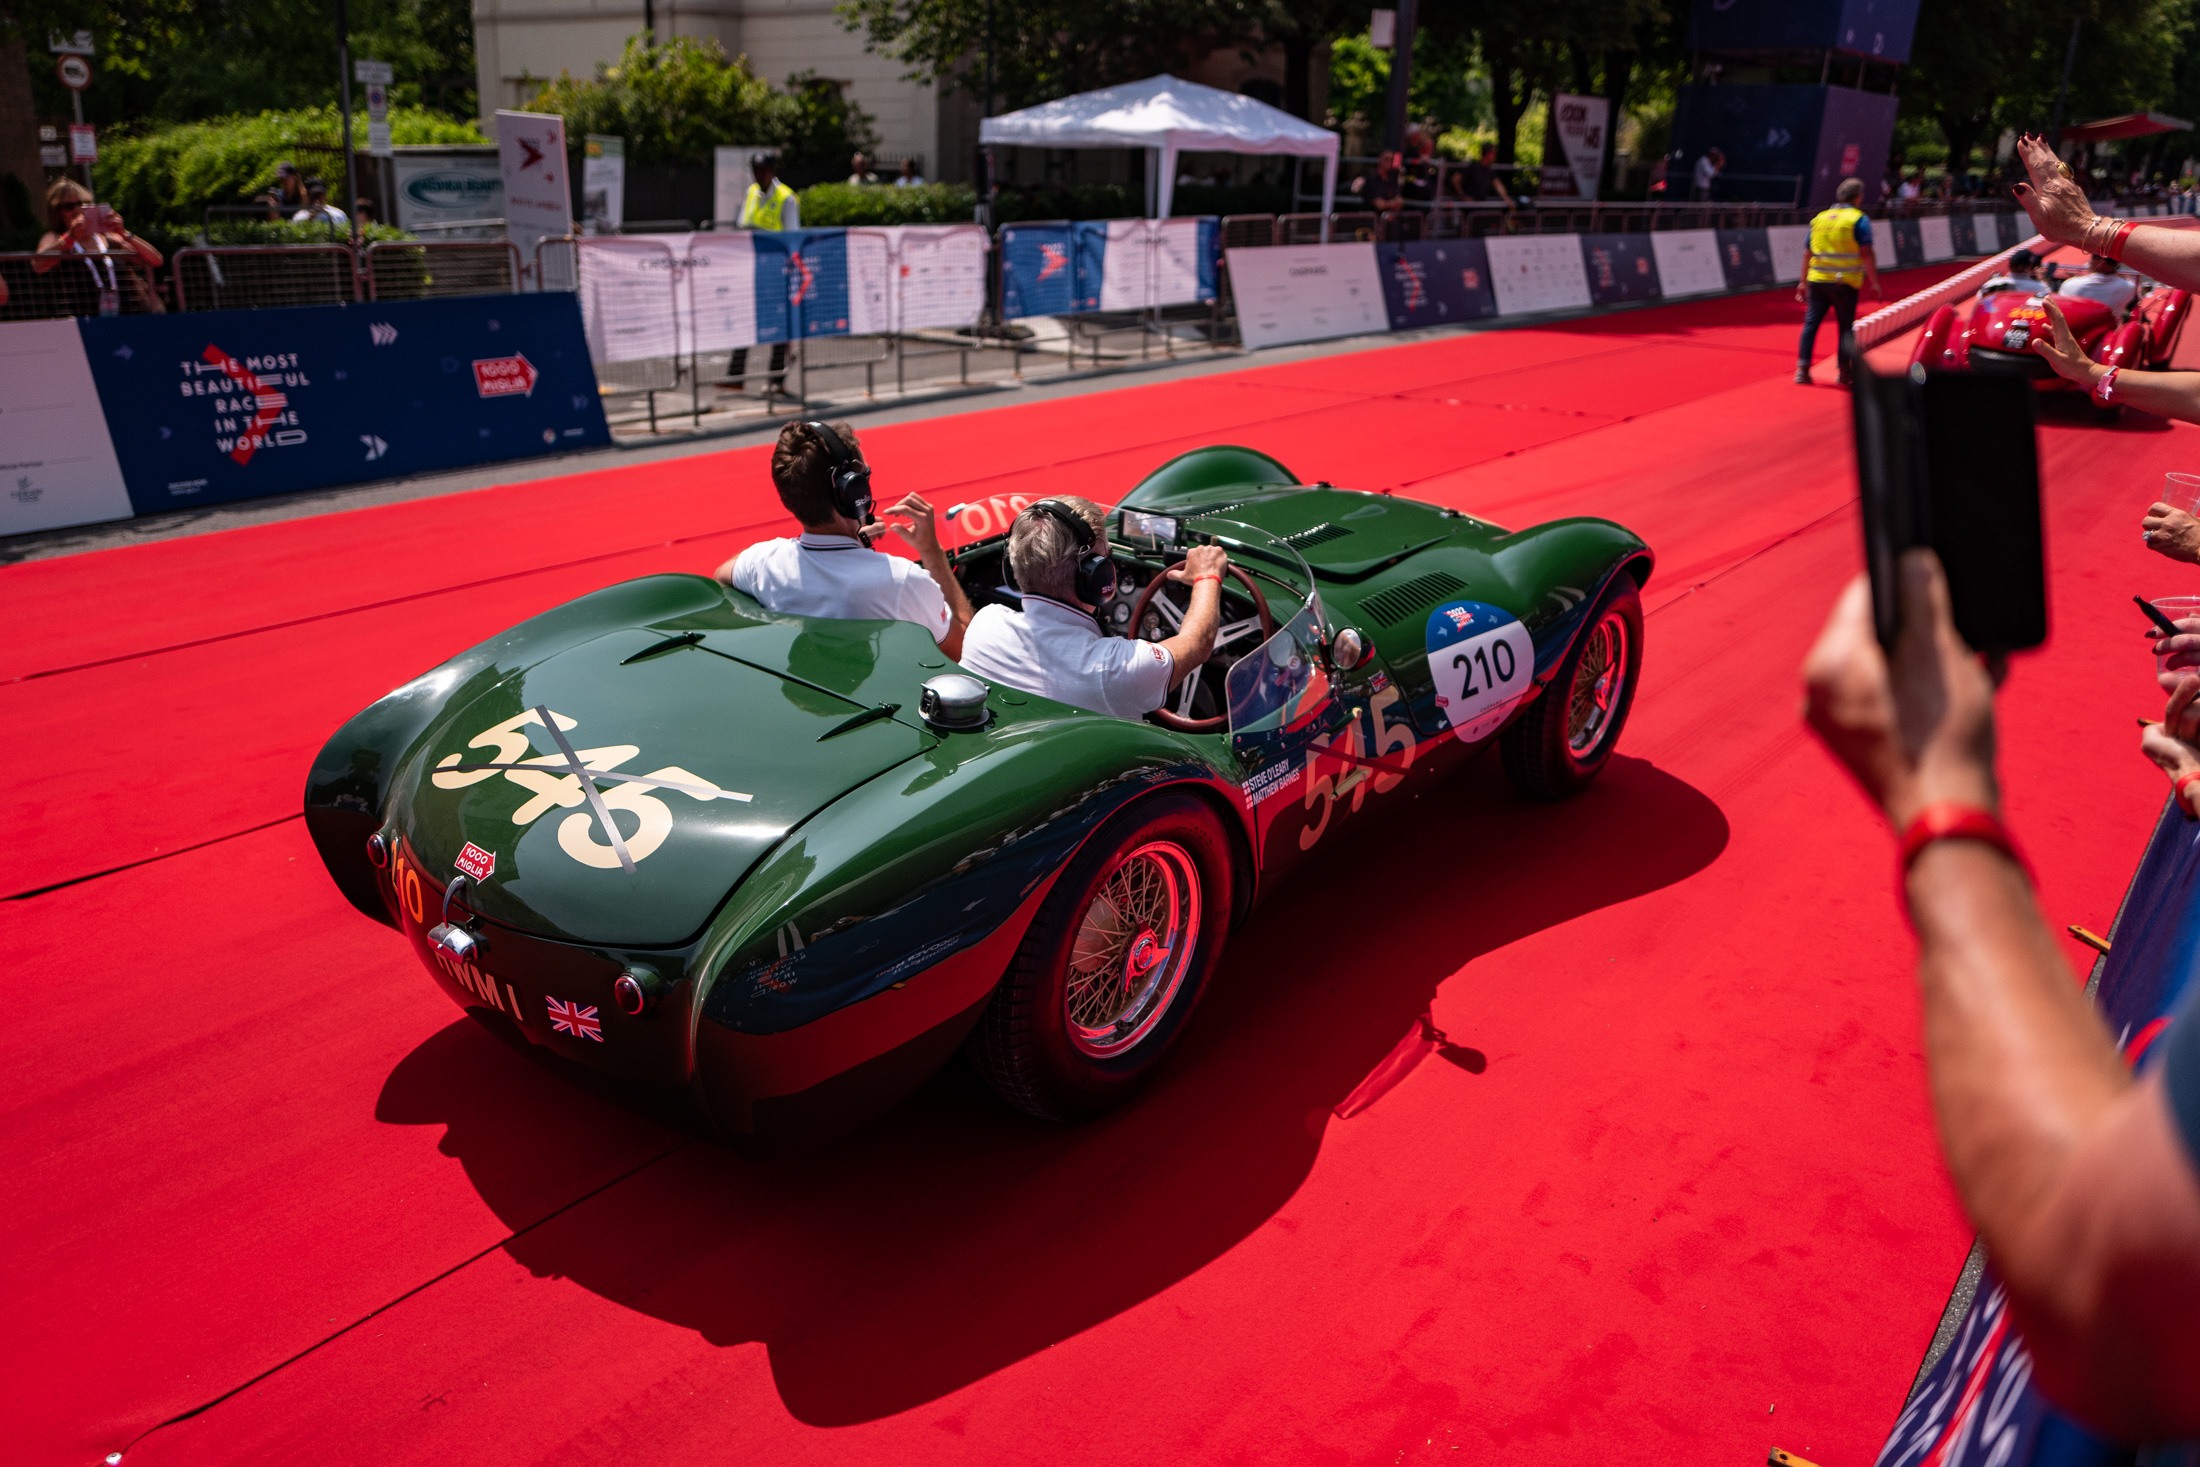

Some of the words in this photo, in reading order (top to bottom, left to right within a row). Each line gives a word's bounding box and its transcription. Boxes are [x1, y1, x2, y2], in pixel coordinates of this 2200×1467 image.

[180, 358, 240, 376] THE
[246, 353, 299, 371] MOST
[480, 361, 521, 377] 1000
[180, 371, 311, 397] BEAUTIFUL
[483, 376, 527, 392] MIGLIA
[215, 392, 289, 414] RACE
[214, 417, 238, 434] IN
[243, 411, 300, 430] THE
[216, 429, 308, 453] WORLD
[1453, 638, 1516, 700] 210
[1248, 770, 1268, 791] STEVE
[1267, 758, 1290, 781] O'LEARY
[1299, 685, 1416, 850] 545
[432, 707, 721, 869] 545
[1253, 780, 1279, 806] MATTHEW
[1278, 768, 1300, 790] BARNES
[458, 857, 483, 877] MIGLIA
[466, 847, 488, 865] 1000
